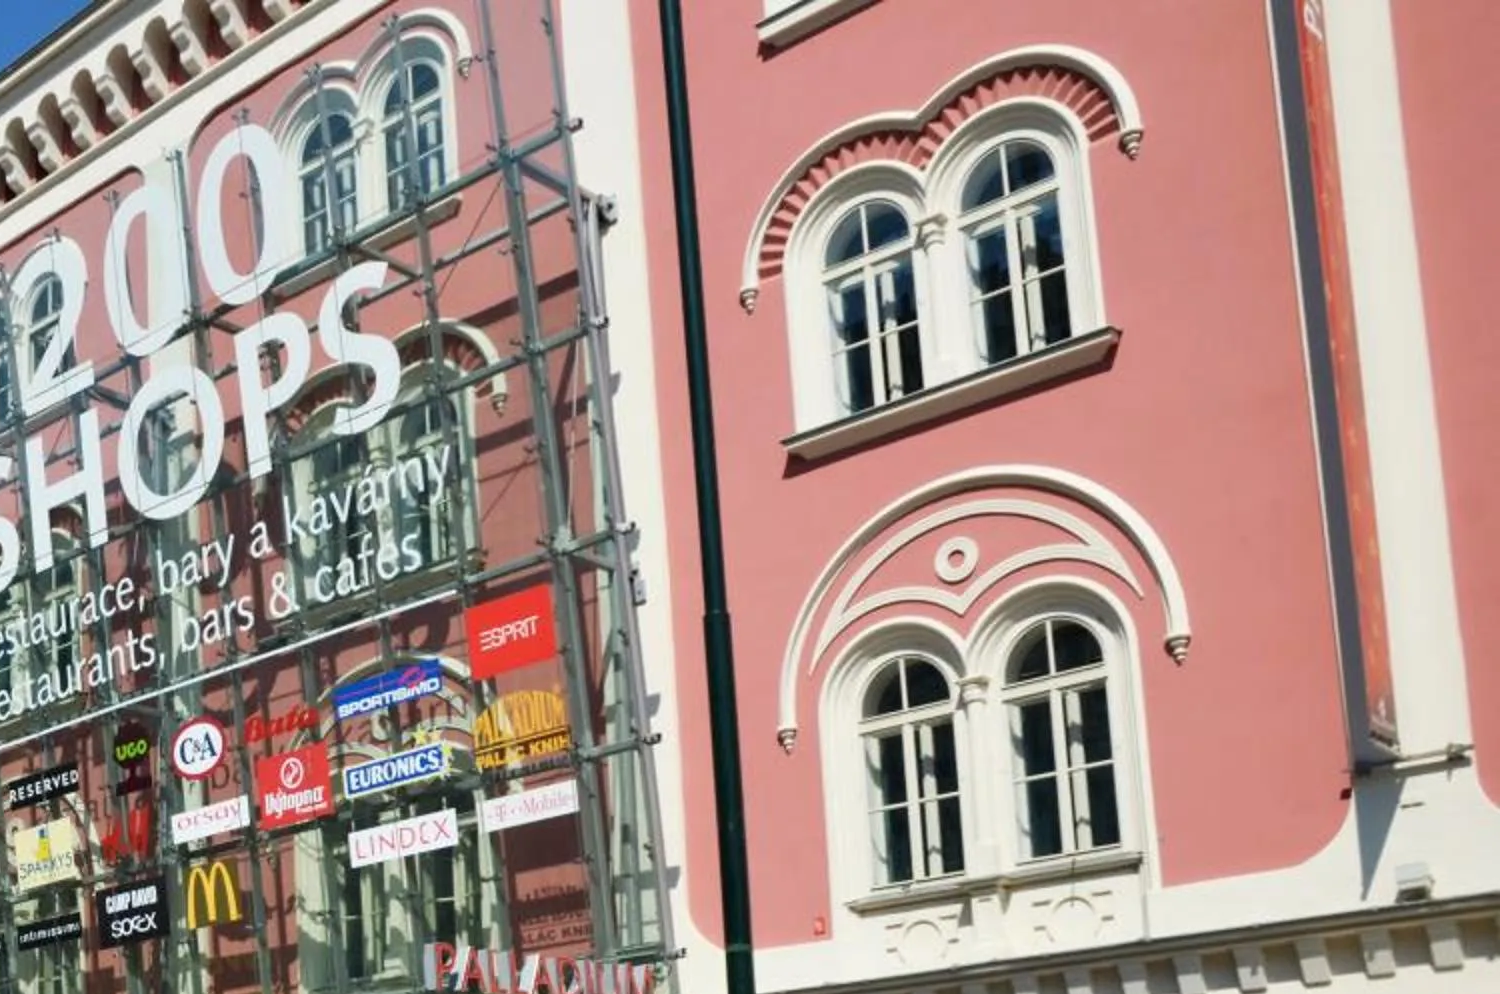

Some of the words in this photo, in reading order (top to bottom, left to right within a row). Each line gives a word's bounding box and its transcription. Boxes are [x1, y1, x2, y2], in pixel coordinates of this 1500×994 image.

[156, 530, 234, 595] bary
[251, 521, 275, 559] a
[282, 443, 450, 545] kavárny
[178, 594, 256, 655] bars
[269, 571, 300, 619] &
[478, 614, 541, 652] ESPRIT
[336, 676, 441, 720] SPORTISIMO
[115, 739, 148, 761] UGO
[179, 731, 218, 765] C&A
[8, 768, 79, 803] RESERVED
[348, 748, 444, 792] EURONICS
[176, 801, 242, 831] orsay
[354, 816, 451, 861] LINDEX
